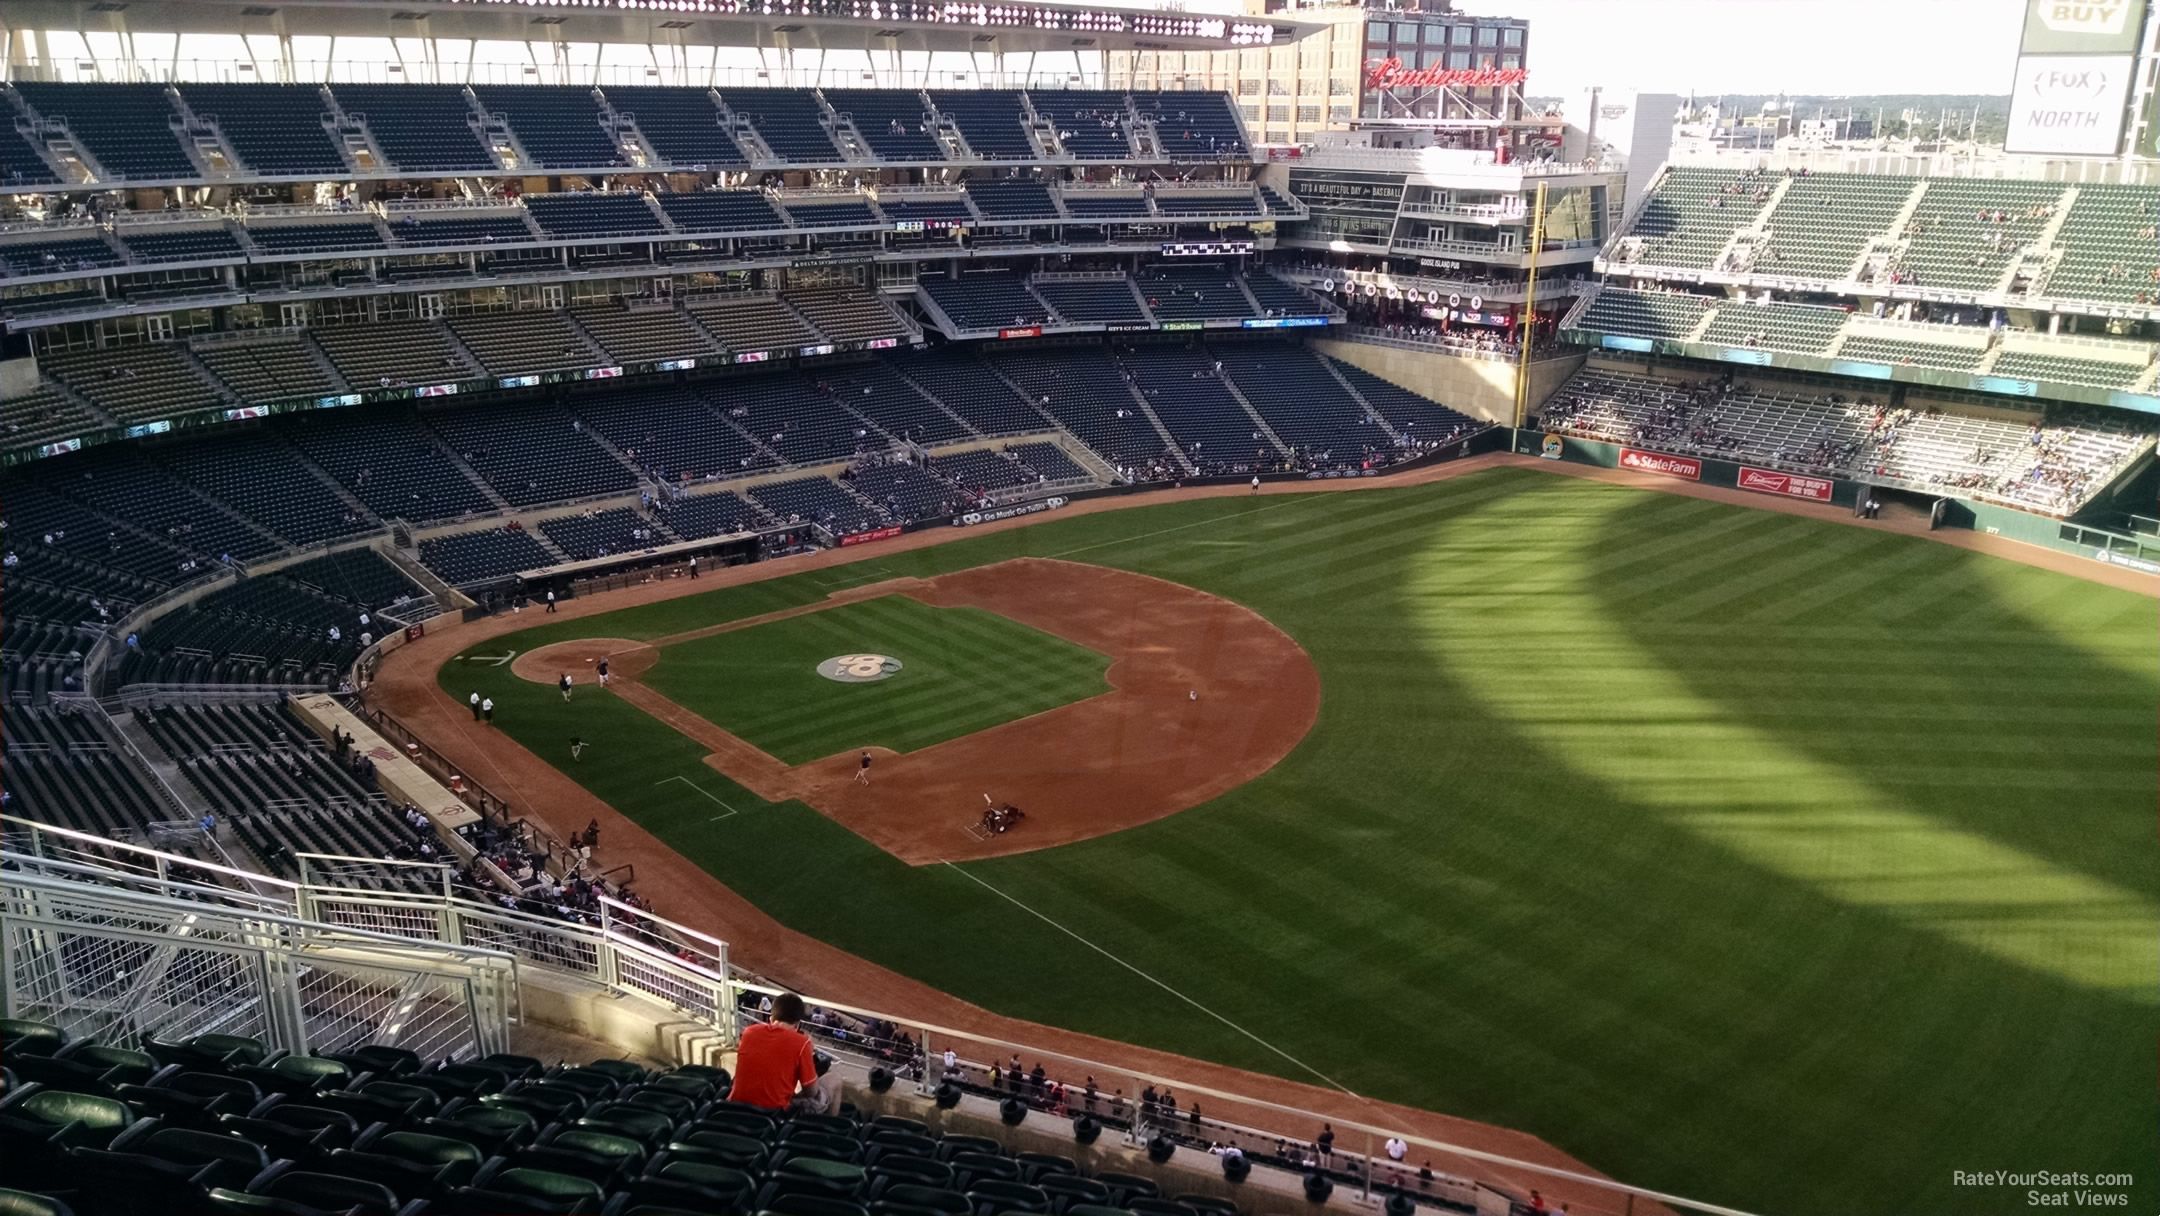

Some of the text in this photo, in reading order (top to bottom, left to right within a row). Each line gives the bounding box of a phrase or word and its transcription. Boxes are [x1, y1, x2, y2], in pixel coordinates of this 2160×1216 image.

[2051, 6, 2117, 23] BUY
[1364, 56, 1530, 90] Budweiser
[2049, 71, 2090, 88] FOX
[2027, 109, 2100, 128] NORTH
[1300, 184, 1312, 192] IT'S
[1314, 184, 1318, 192] A
[1319, 184, 1349, 195] BEAUTIFUL
[1350, 186, 1361, 195] DAY
[1372, 187, 1401, 198] BASEBALL
[1339, 220, 1360, 231] TWINS
[1361, 221, 1389, 230] TERRITORY
[1420, 258, 1460, 270] GOOSE ISLAND PUB
[1788, 486, 1802, 494] FOR
[1789, 478, 1827, 490] THIS BUD'S
[1002, 509, 1021, 519] Music
[1032, 504, 1050, 513] Twins
